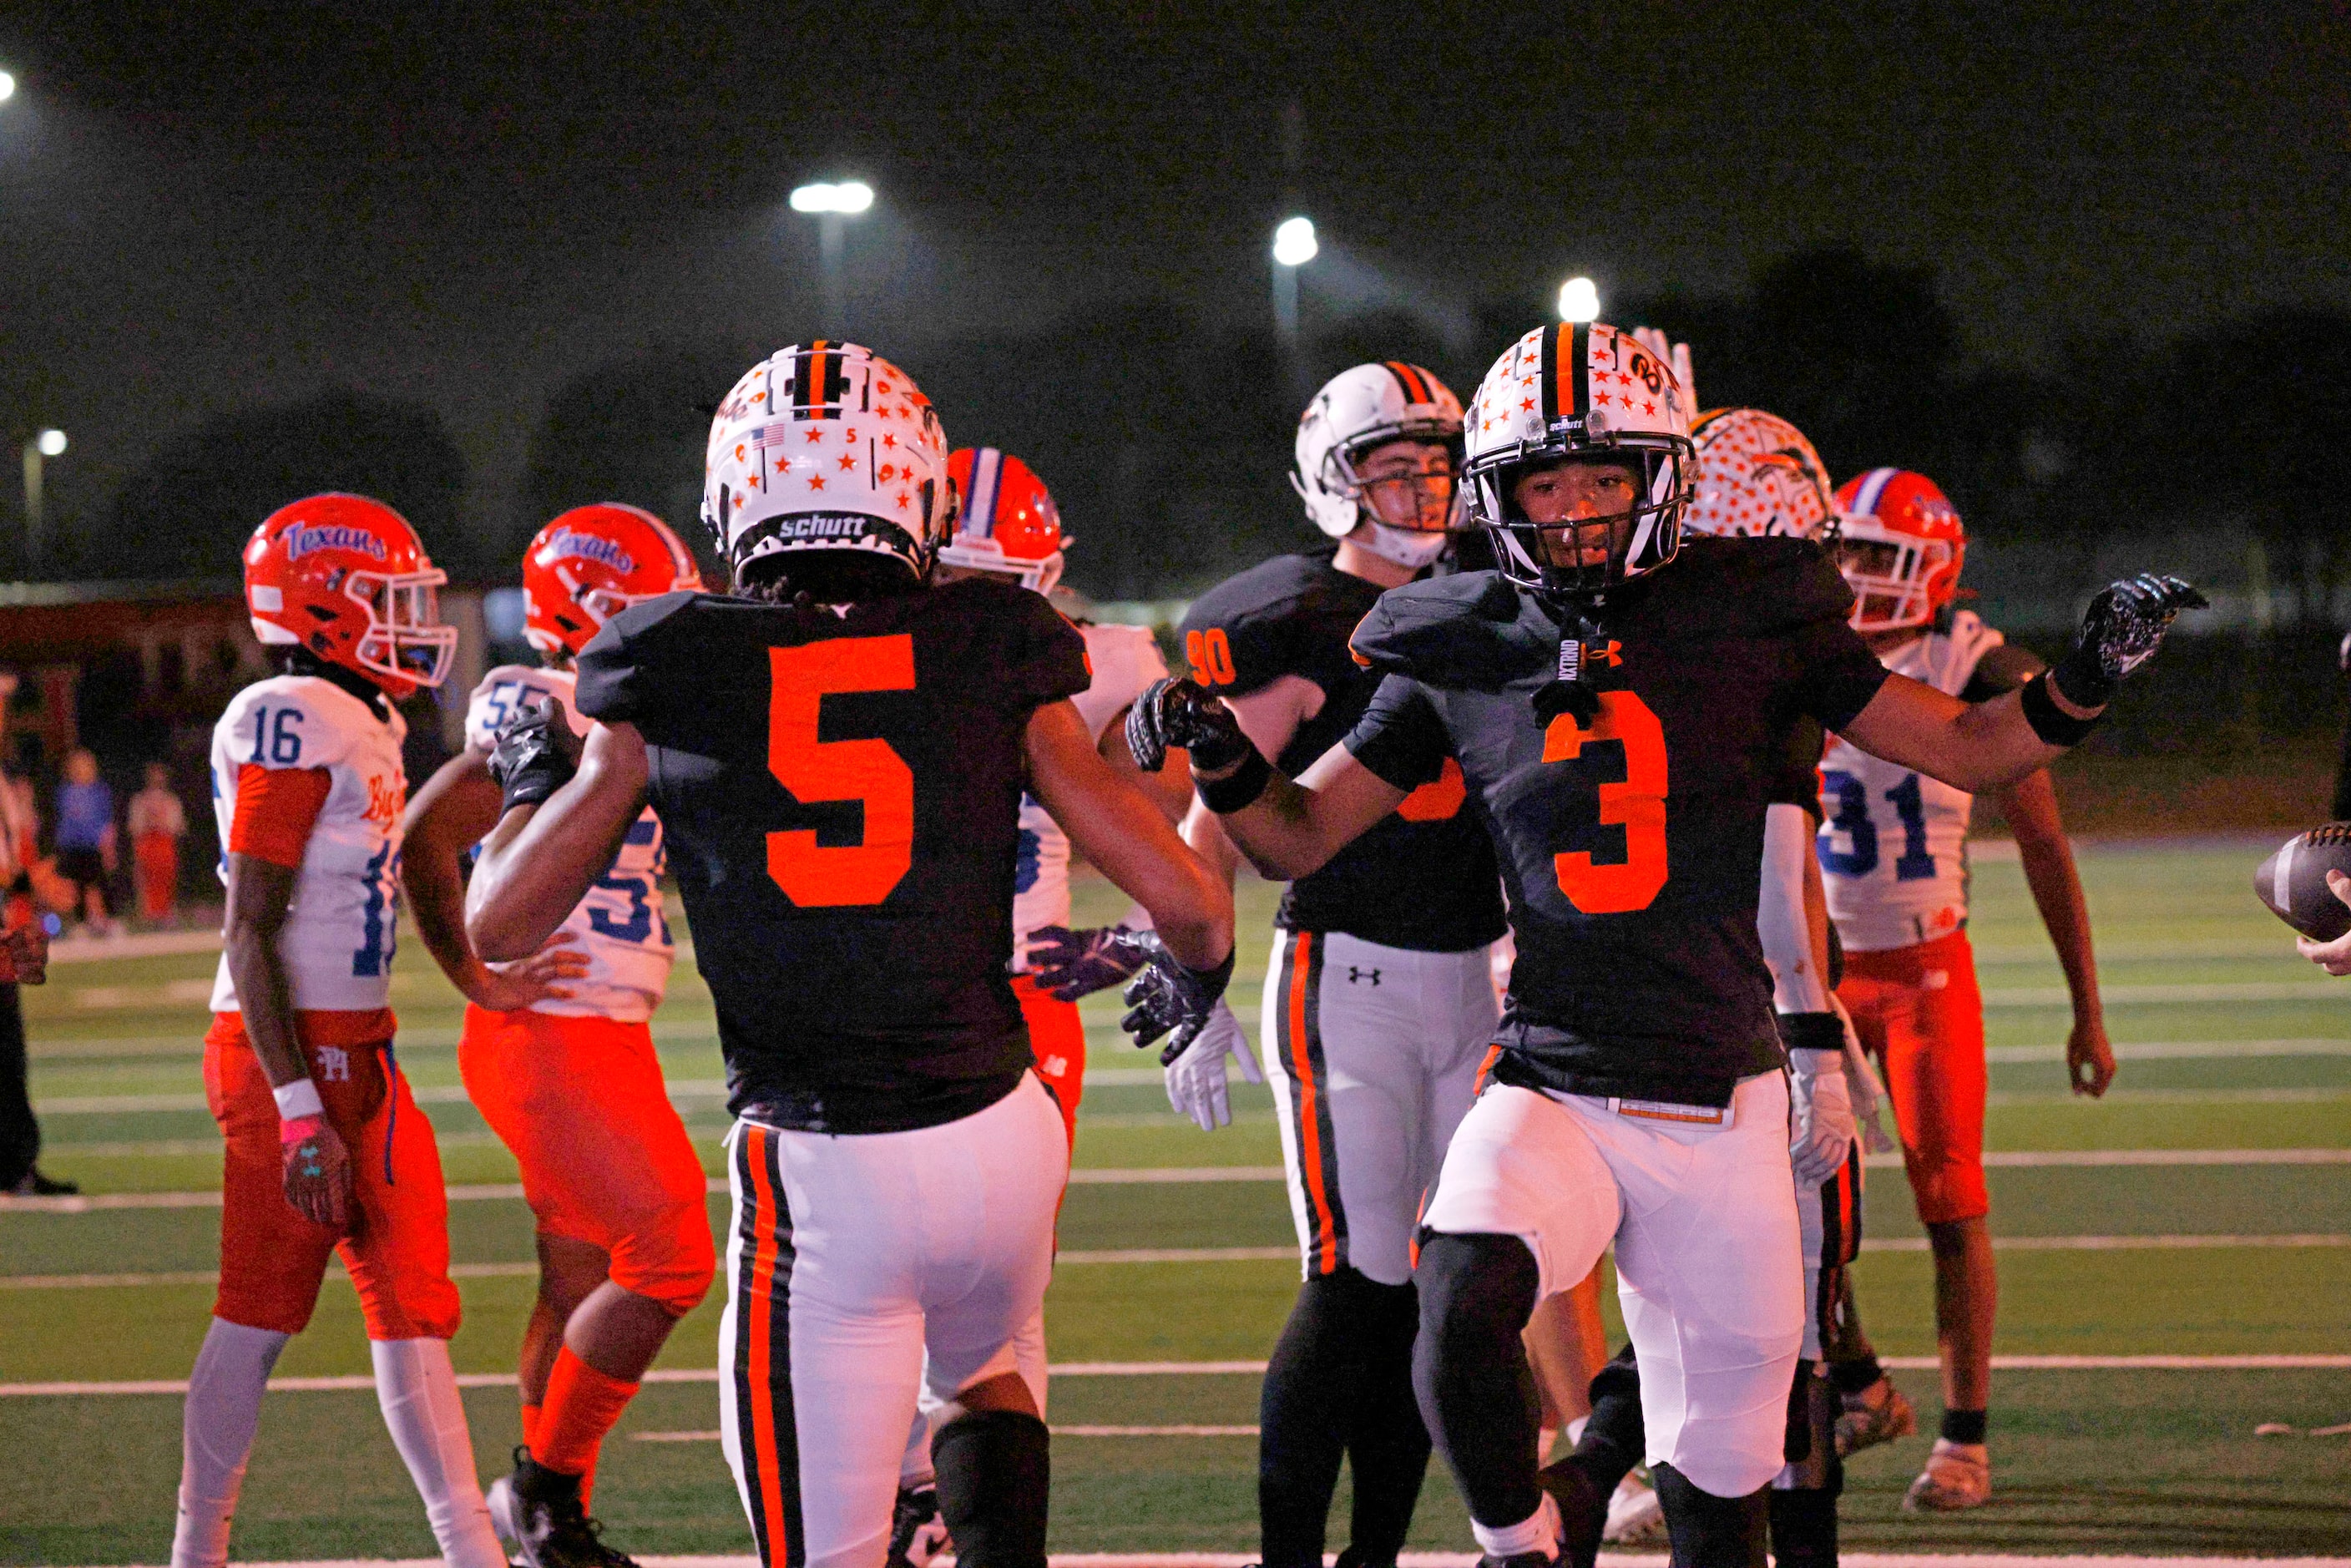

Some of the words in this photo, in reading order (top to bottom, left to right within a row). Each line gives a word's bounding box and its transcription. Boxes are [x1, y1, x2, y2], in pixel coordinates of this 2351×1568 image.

[846, 427, 857, 443] 5
[1550, 419, 1583, 432] schutt
[283, 519, 388, 562] Texans
[779, 513, 866, 539] schutt
[1186, 627, 1236, 687] 90
[1558, 640, 1580, 681] NXTRND
[250, 706, 305, 763] 16
[766, 633, 916, 907] 5
[1541, 690, 1668, 913] 3
[1816, 770, 1937, 883] 31
